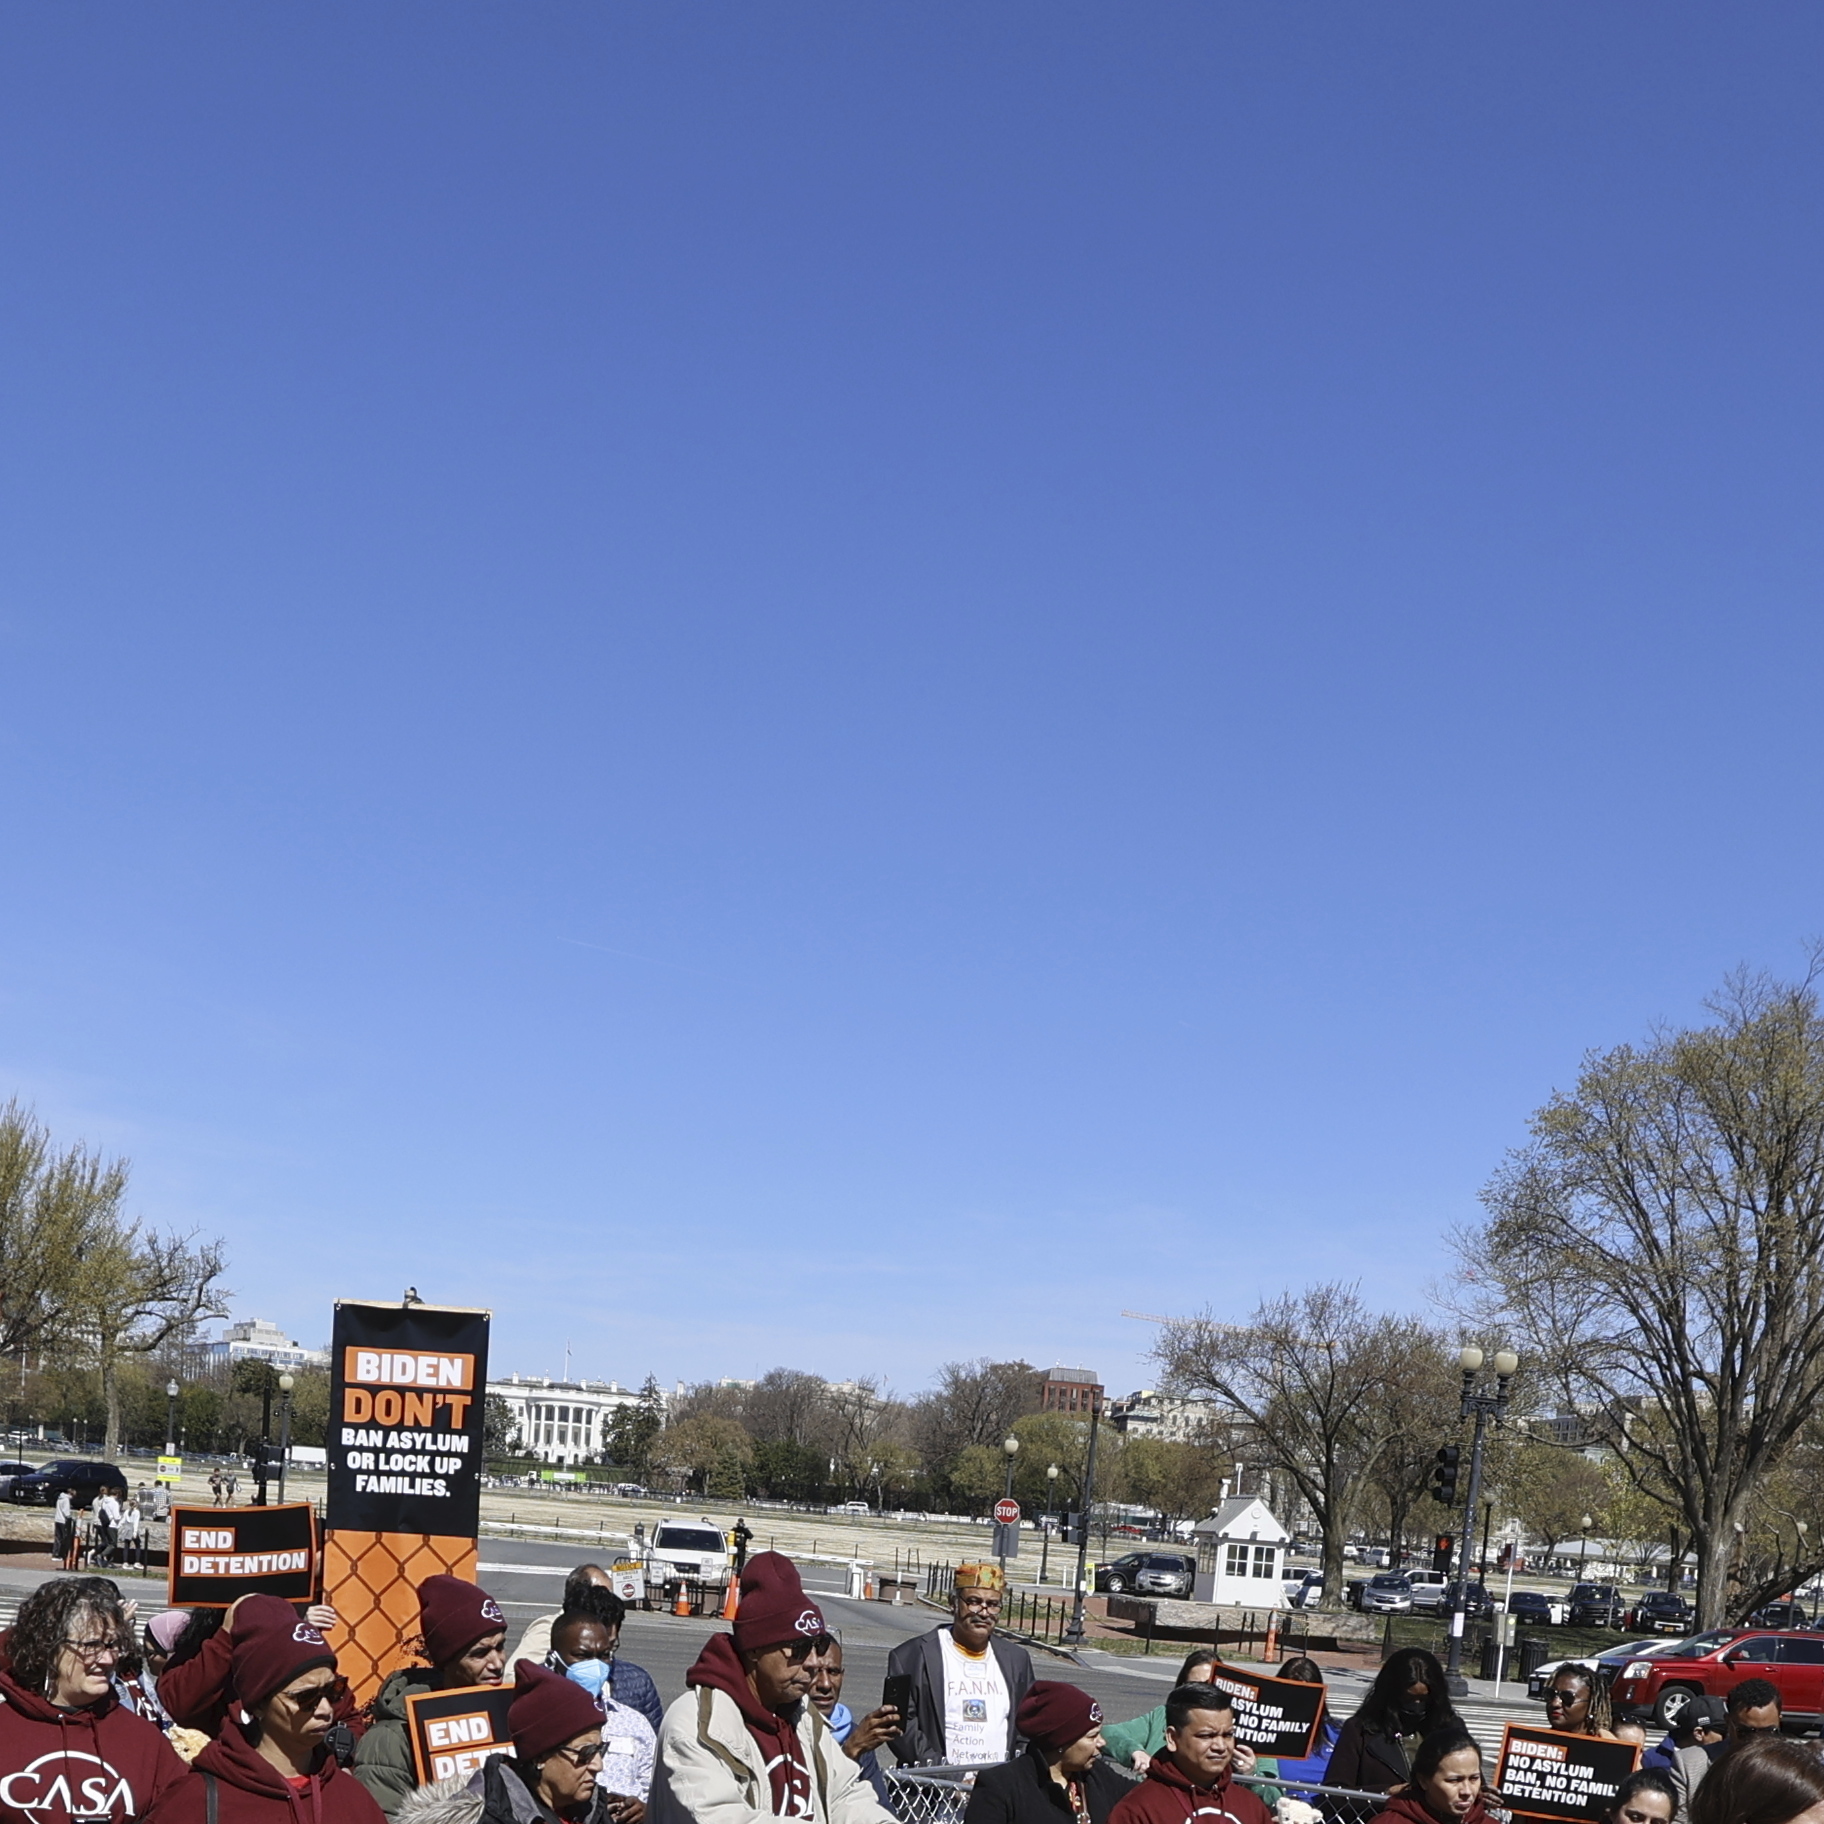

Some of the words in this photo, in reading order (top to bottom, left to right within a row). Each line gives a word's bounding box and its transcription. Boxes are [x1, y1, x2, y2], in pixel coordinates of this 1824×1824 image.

[357, 1352, 463, 1387] BIDEN
[341, 1428, 383, 1447] BAN
[386, 1431, 469, 1453] ASYLUM
[346, 1451, 375, 1470] OR
[379, 1453, 430, 1473] LOCK
[434, 1457, 462, 1475] UP
[356, 1474, 451, 1497] FAMILIES.
[996, 1506, 1018, 1517] STOP
[185, 1530, 233, 1549] END
[183, 1552, 306, 1574] DETENTION
[948, 1681, 1003, 1696] F.A.N.M.
[429, 1718, 490, 1746] END
[953, 1723, 985, 1733] Family
[1239, 1713, 1259, 1728] NO
[1261, 1719, 1310, 1734] FAMILY
[953, 1735, 985, 1746] Action
[1511, 1740, 1564, 1760] BIDEN:
[1508, 1755, 1530, 1769] NO
[1532, 1760, 1594, 1780] ASYLUM
[1505, 1768, 1541, 1788] BAN,
[1545, 1775, 1568, 1790] NO
[0, 1772, 136, 1816] CASA
[1503, 1783, 1588, 1807] DETENTION
